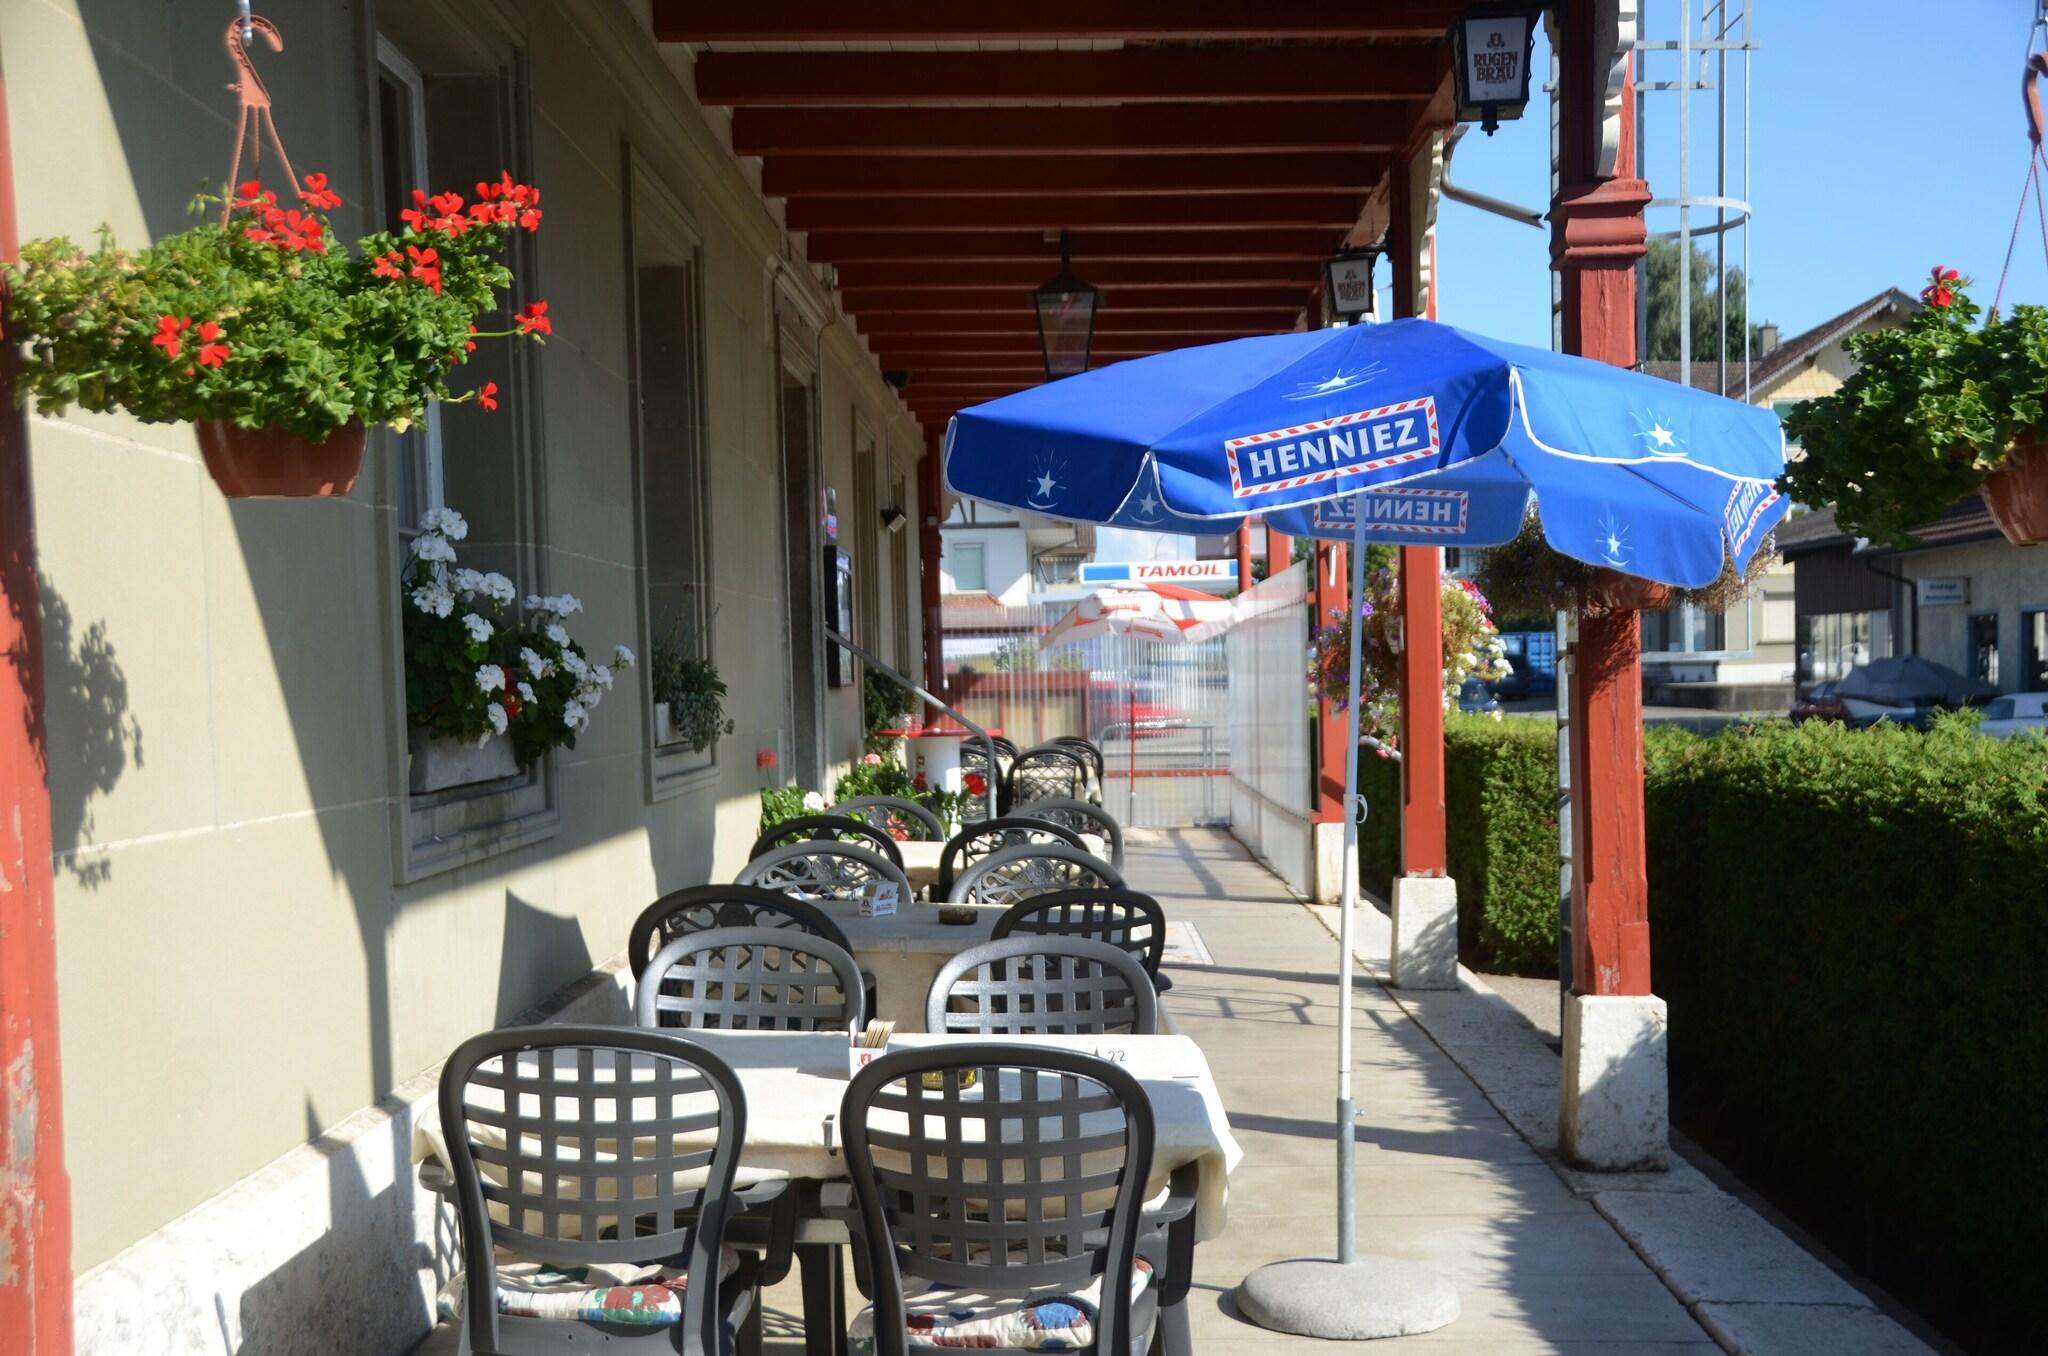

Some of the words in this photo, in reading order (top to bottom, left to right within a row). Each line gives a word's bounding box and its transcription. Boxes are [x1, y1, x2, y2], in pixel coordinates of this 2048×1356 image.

[1474, 51, 1518, 68] RUGEN
[1248, 417, 1418, 478] HENNIEZ
[1136, 564, 1222, 578] TAMOIL
[1107, 1050, 1126, 1062] 22
